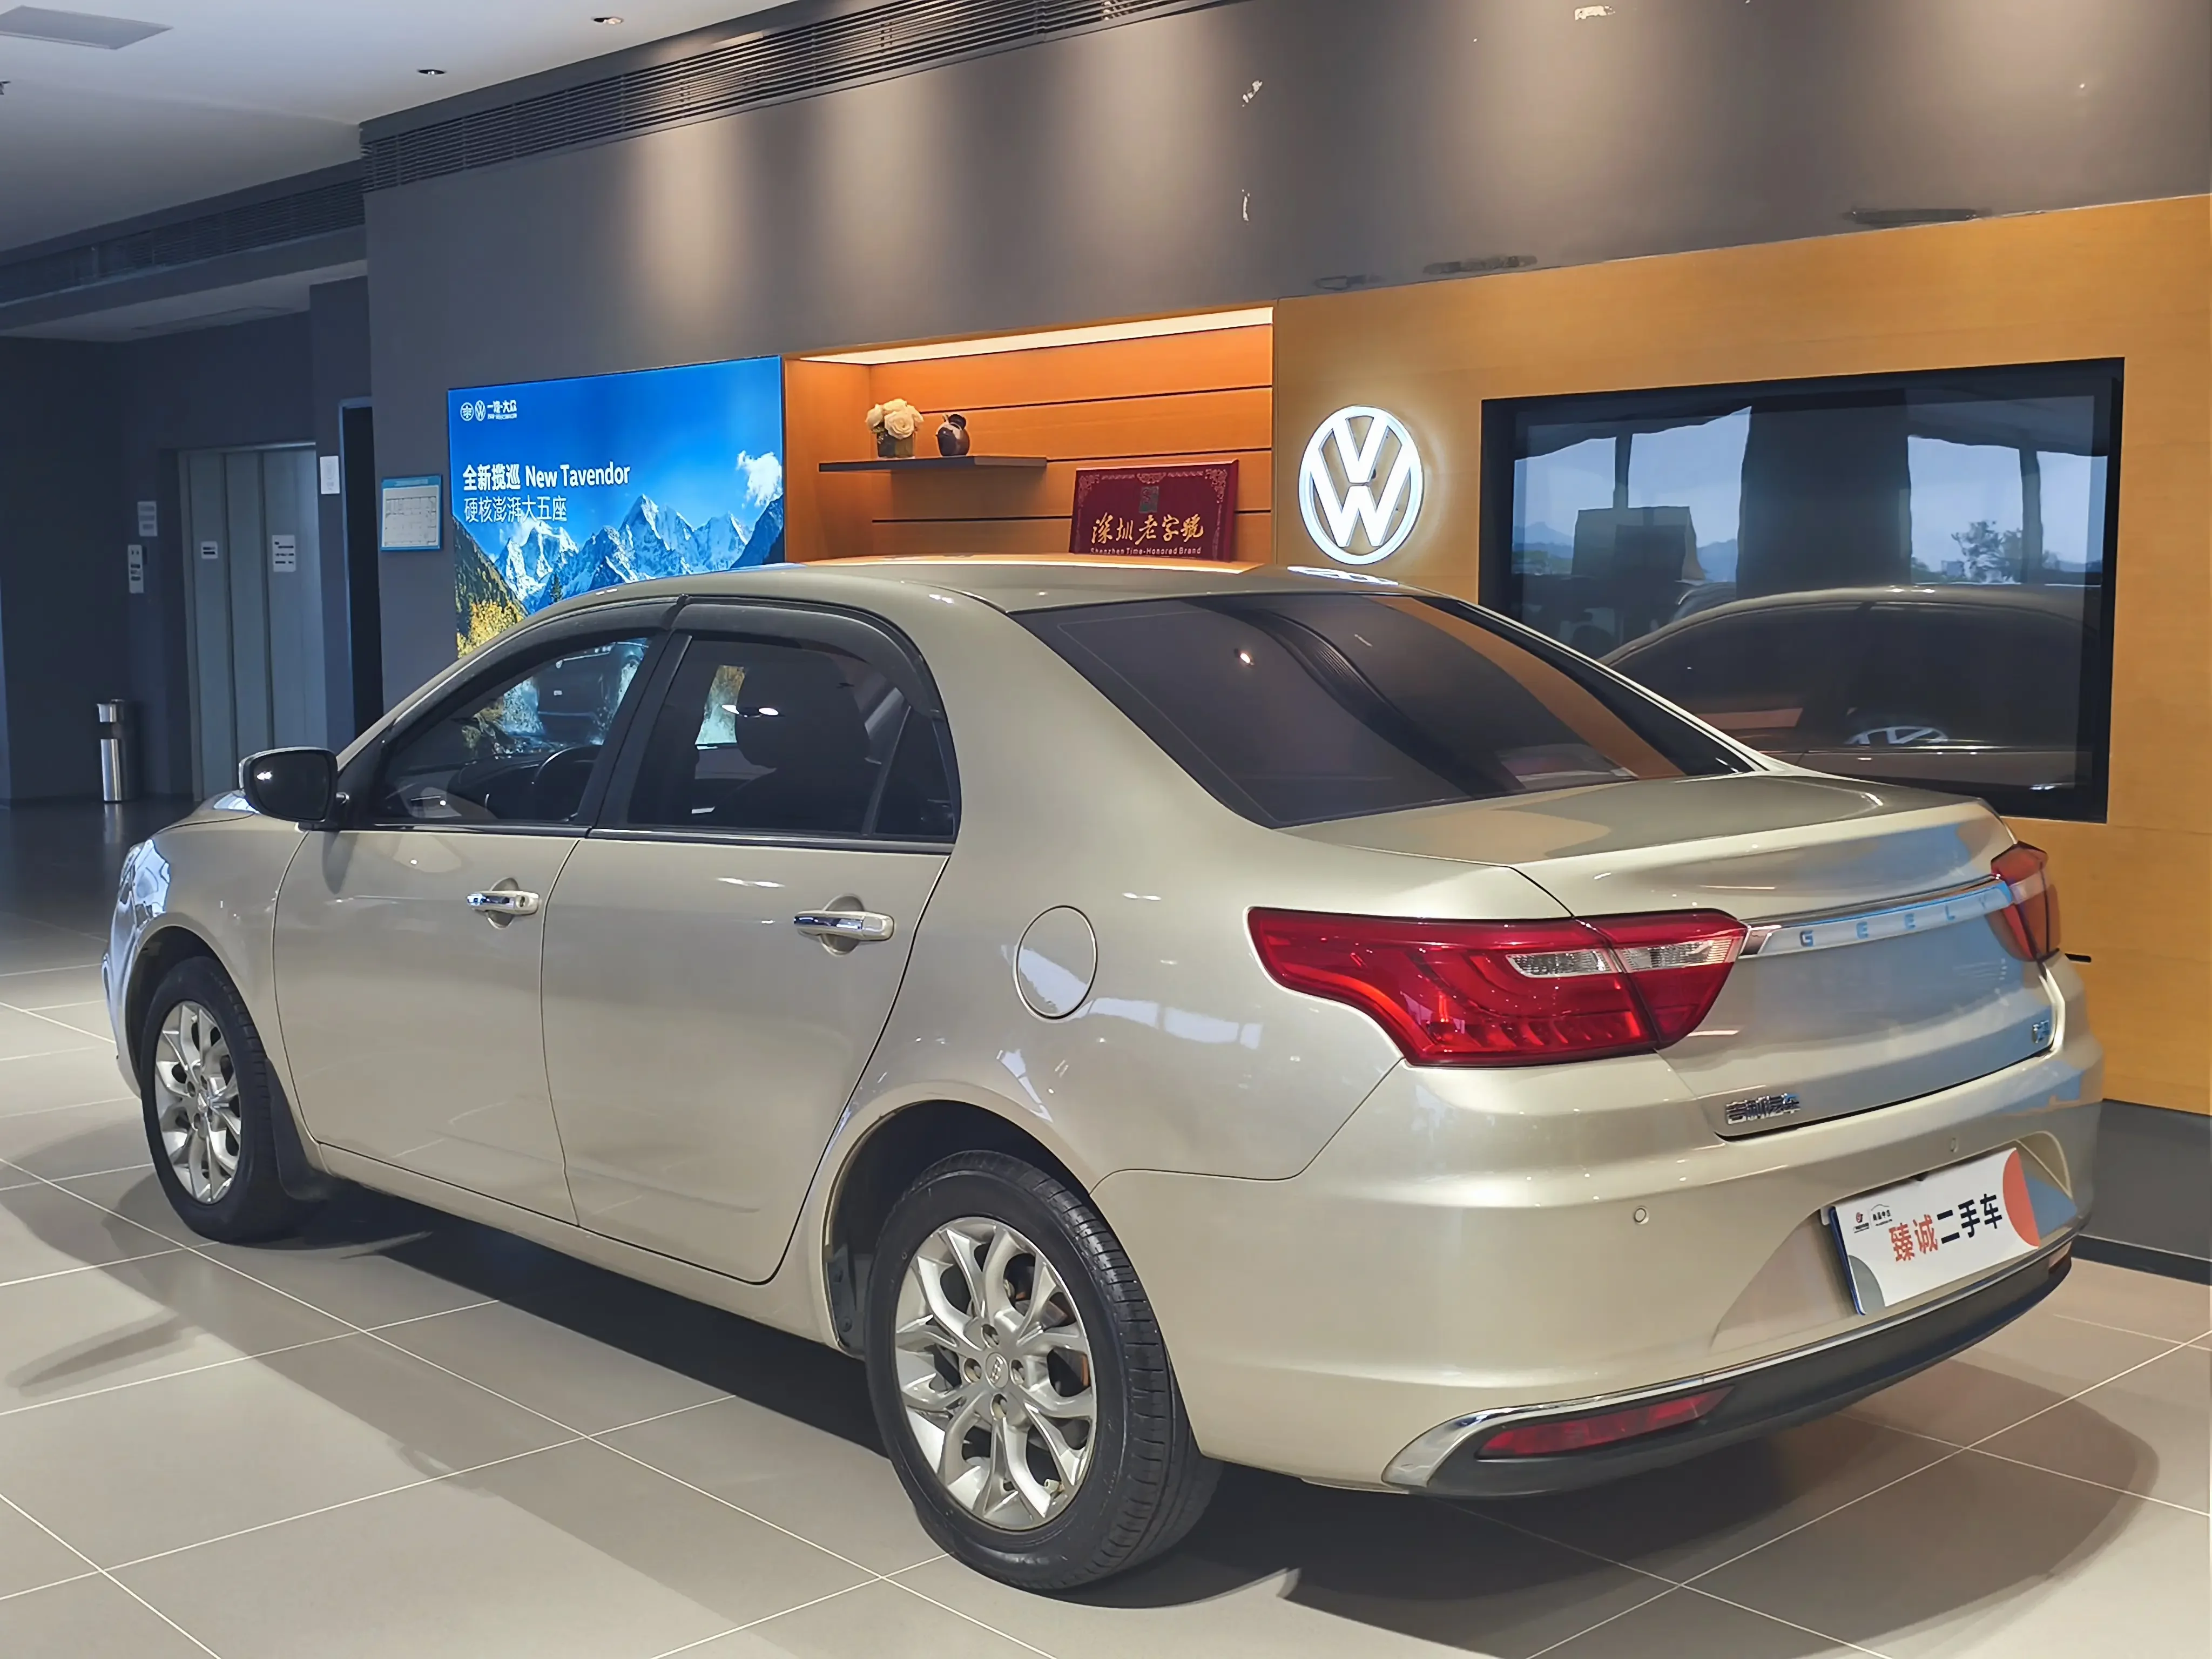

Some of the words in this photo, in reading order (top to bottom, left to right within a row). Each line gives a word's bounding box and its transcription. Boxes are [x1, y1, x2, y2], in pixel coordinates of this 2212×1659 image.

[462, 463, 521, 491] 全新揽巡
[525, 465, 557, 488] New
[559, 460, 630, 487] Tavendor
[463, 495, 568, 523] 硬核澎湃大五座
[1179, 546, 1202, 554] Brand
[1889, 1193, 2002, 1262] 臻诚二手车
